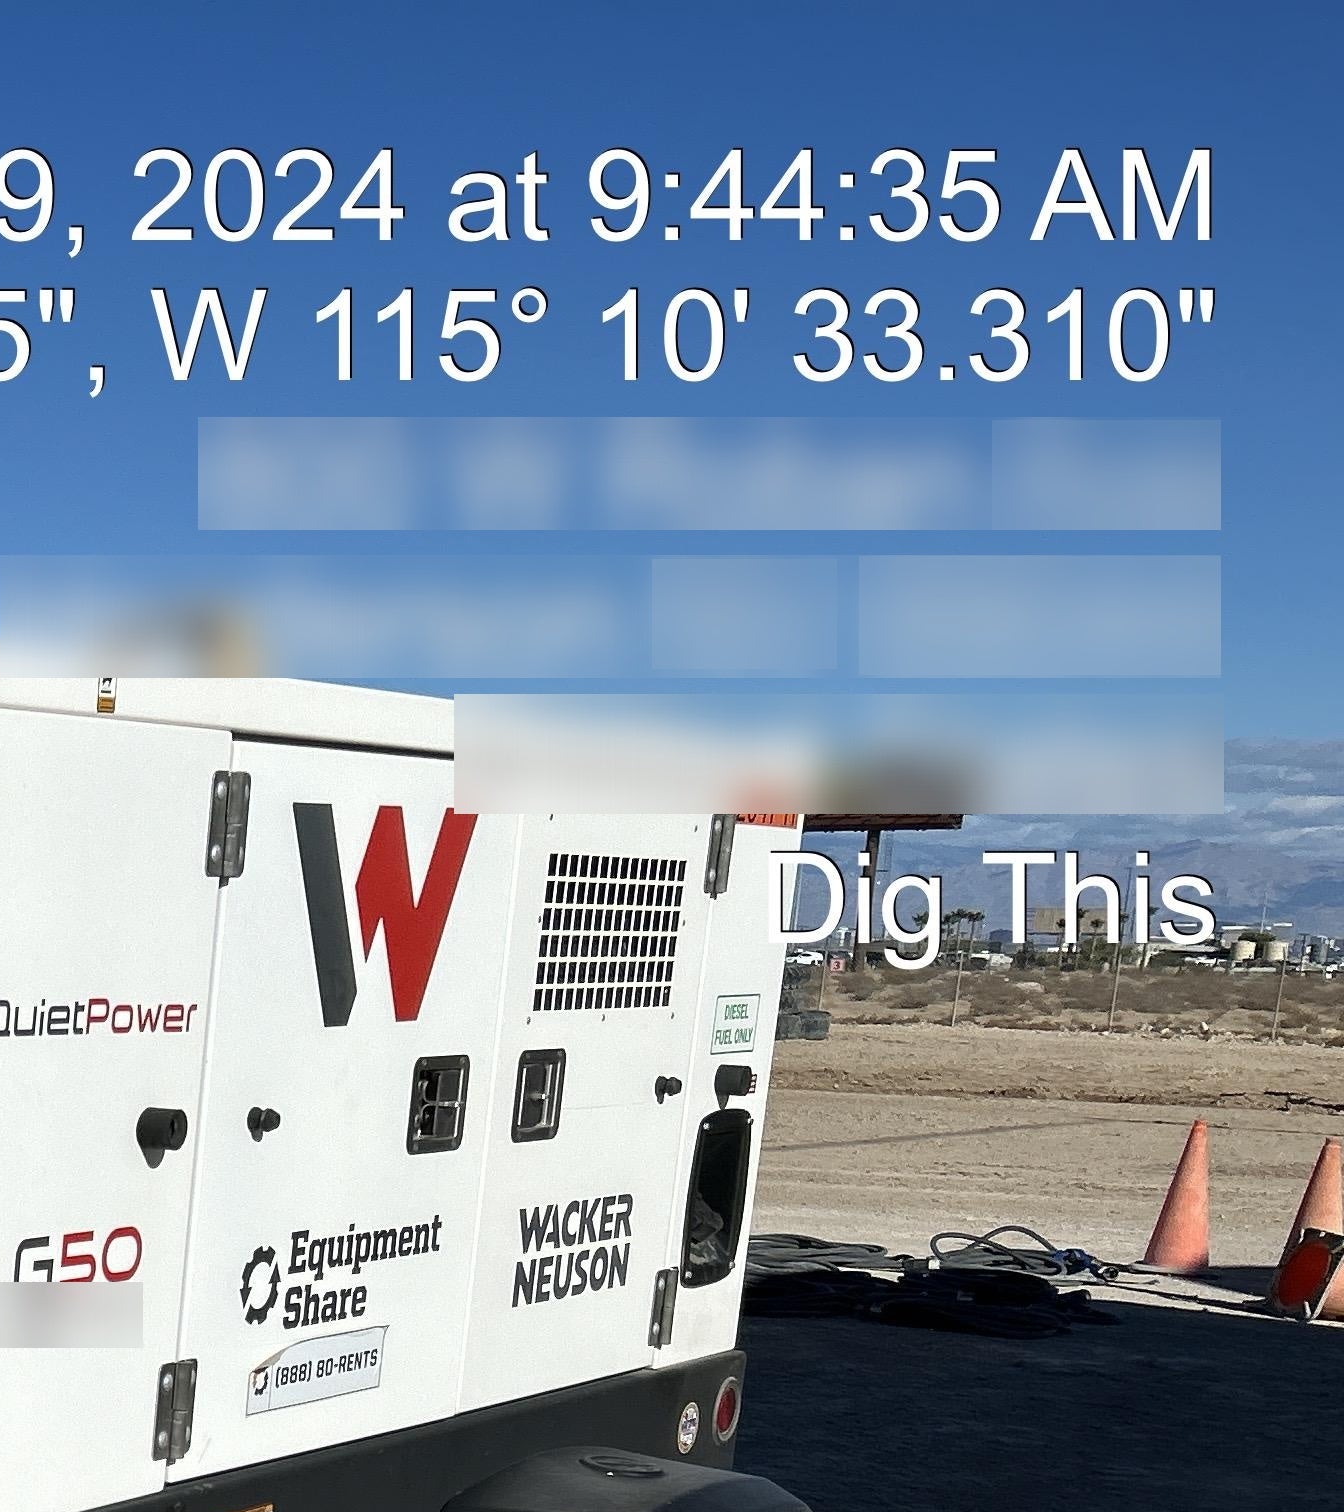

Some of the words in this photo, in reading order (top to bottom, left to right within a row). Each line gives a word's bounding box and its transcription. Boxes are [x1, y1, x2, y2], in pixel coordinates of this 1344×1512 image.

[714, 1028, 732, 1045] FUEL
[734, 1027, 753, 1044] ONLY
[724, 1003, 749, 1021] DIESEL
[287, 1215, 442, 1281] Equipment
[519, 1193, 633, 1254] WACKER
[14, 1226, 142, 1283] G50
[511, 1243, 630, 1308] NEUSON
[282, 1284, 368, 1330] Share
[275, 1360, 312, 1388] (888)
[316, 1349, 378, 1379] 80-RENTS
